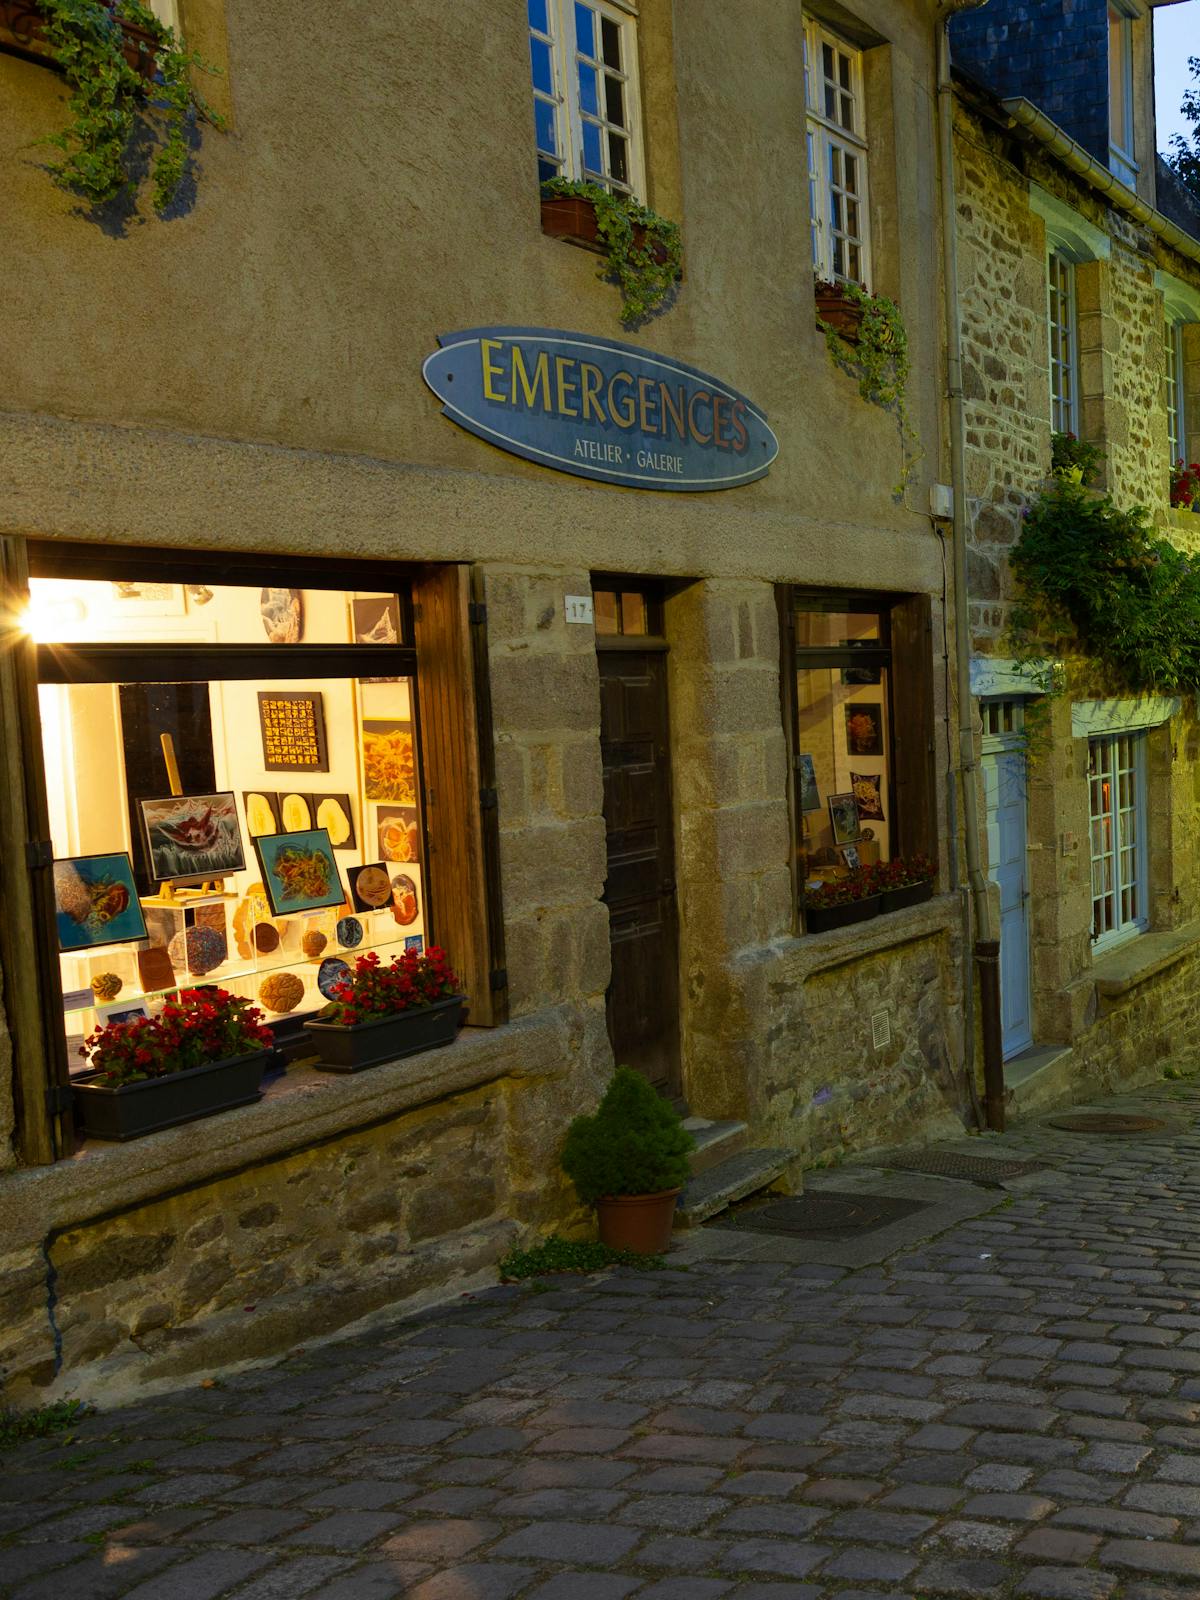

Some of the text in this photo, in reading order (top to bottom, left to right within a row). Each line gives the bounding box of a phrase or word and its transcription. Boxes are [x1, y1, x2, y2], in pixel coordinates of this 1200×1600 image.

[480, 338, 748, 451] EMERGENCES
[574, 439, 683, 474] ATELIER GALERIE
[571, 602, 586, 618] 17
